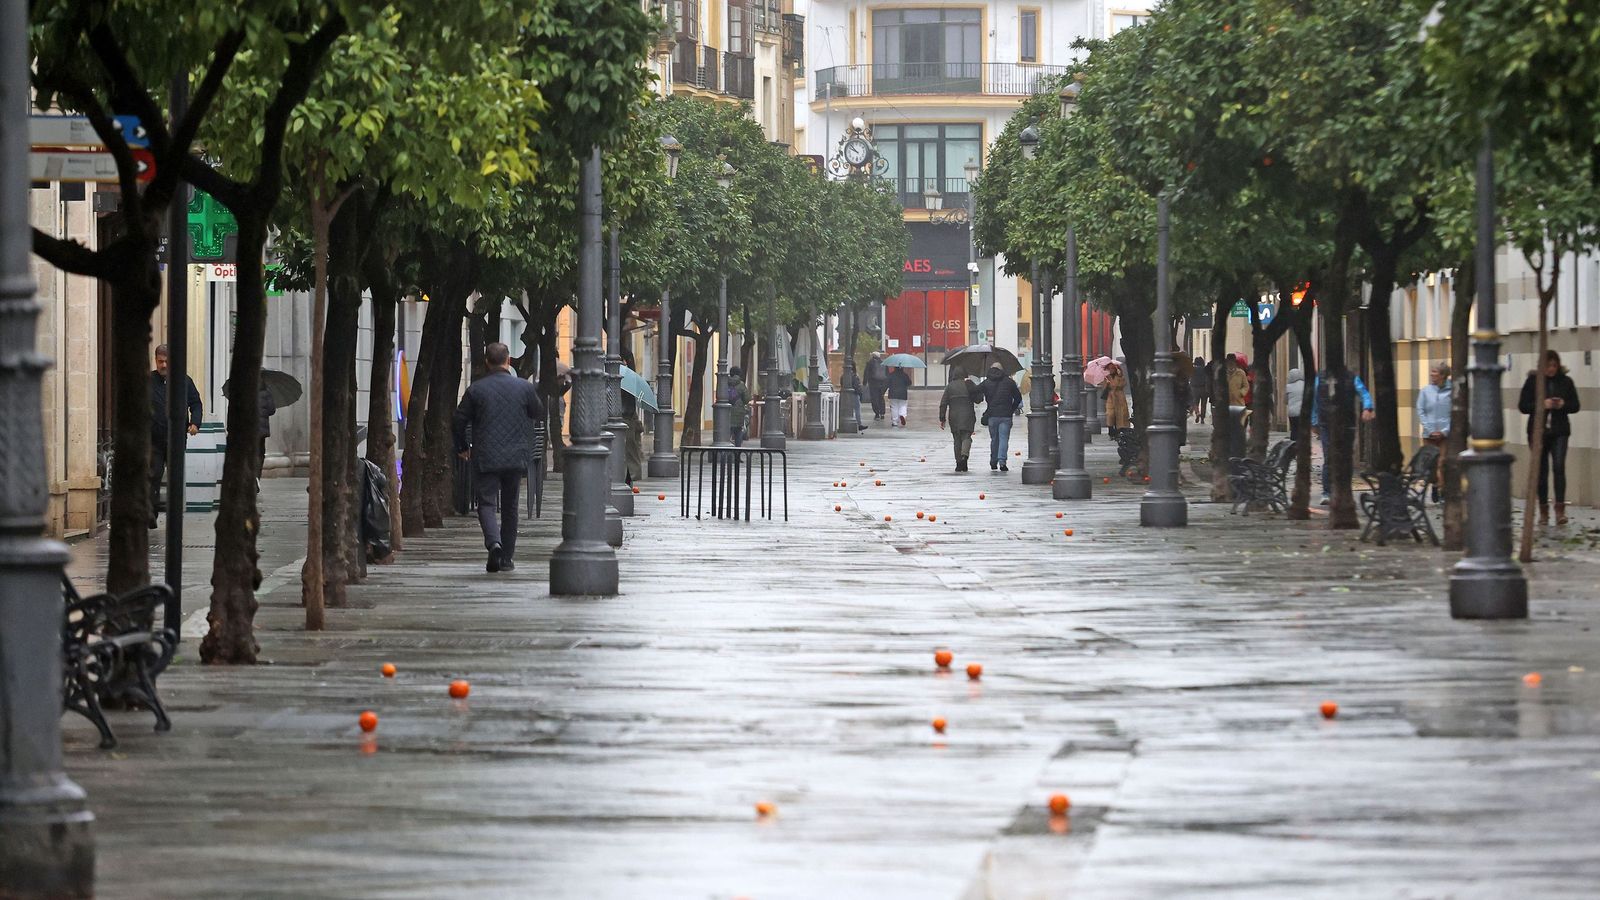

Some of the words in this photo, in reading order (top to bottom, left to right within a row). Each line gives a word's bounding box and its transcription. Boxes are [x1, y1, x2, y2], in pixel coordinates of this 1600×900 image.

[903, 259, 932, 272] AES
[215, 267, 237, 278] Opti
[932, 319, 961, 330] GAES
